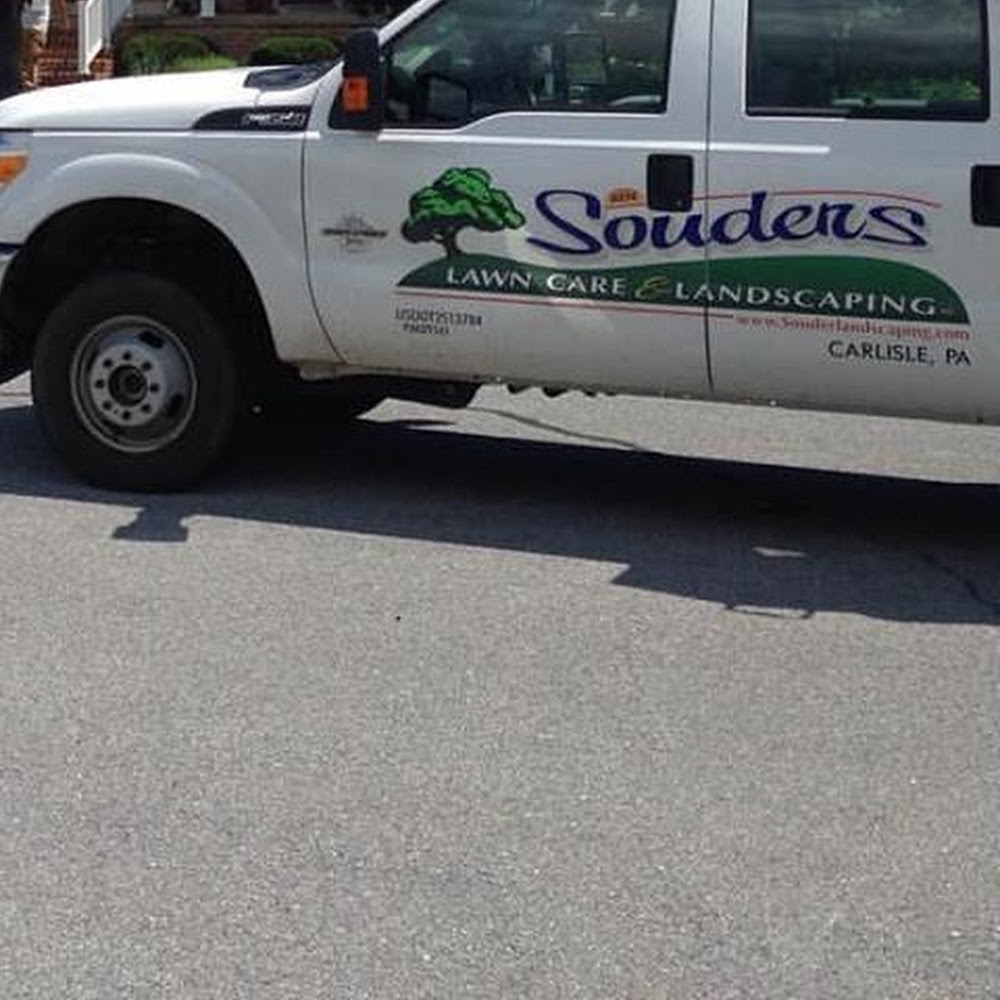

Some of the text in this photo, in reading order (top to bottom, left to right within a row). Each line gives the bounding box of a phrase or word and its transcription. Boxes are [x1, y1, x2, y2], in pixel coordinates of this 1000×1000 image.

[527, 189, 928, 255] Souders
[446, 266, 532, 289] LAWN
[546, 272, 626, 296] CARE
[674, 281, 935, 316] LANDSCAPING
[828, 340, 971, 367] CARLISLE, PA
